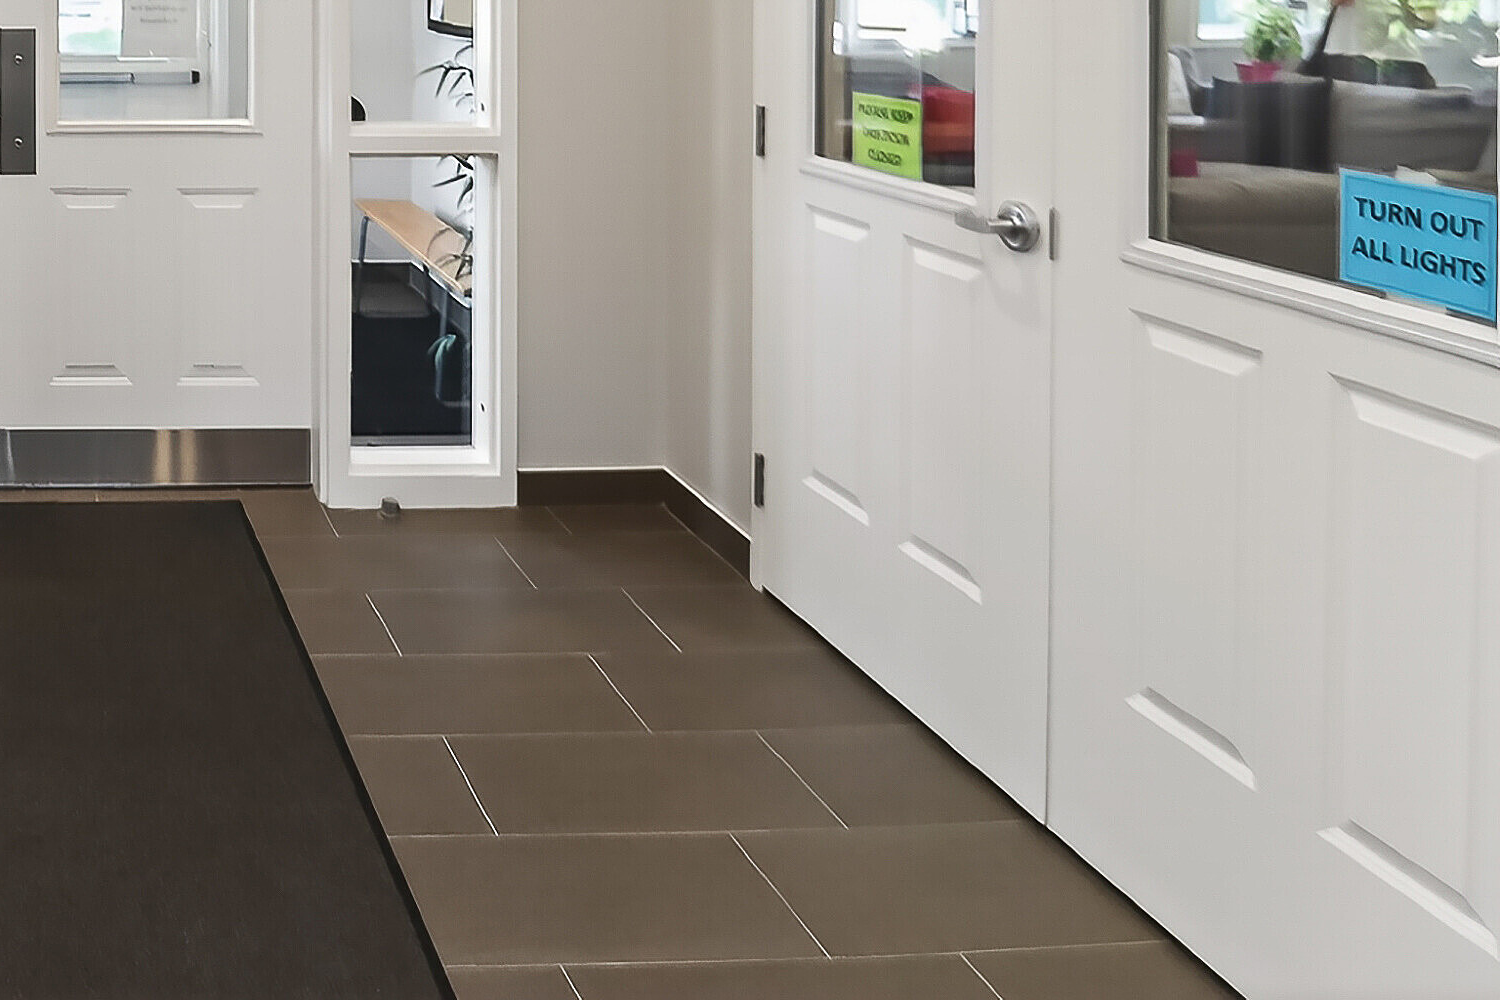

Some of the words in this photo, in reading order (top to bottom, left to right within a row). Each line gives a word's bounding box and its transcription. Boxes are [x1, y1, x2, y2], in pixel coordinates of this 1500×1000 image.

[1353, 196, 1423, 231] TURN
[1430, 211, 1486, 241] OUT
[1351, 235, 1395, 264] ALL
[1400, 245, 1487, 287] LIGHTS
